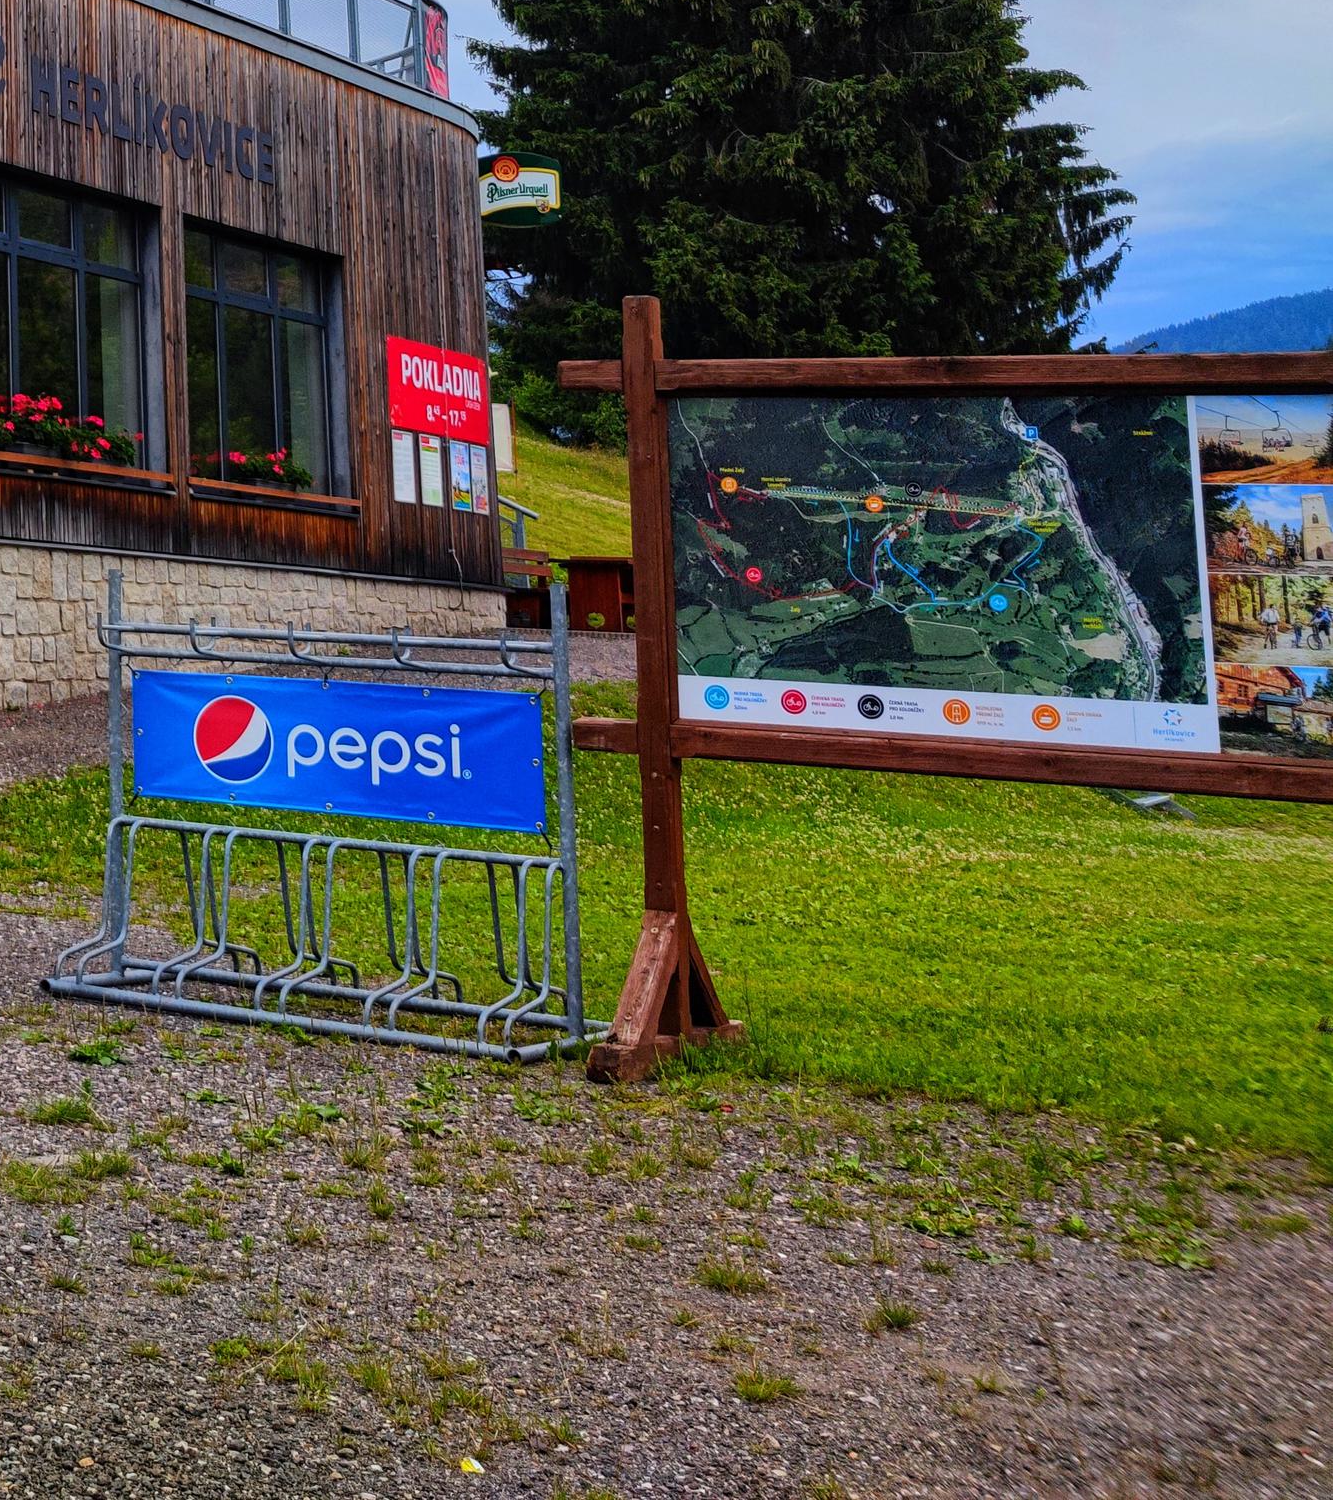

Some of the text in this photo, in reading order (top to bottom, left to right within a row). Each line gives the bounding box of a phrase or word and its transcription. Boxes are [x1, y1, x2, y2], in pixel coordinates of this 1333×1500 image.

[31, 54, 276, 186] HERLÍKOVICE
[486, 181, 549, 203] Pilsner Urquell
[400, 353, 482, 403] POKLADNA
[287, 723, 462, 786] pepsi
